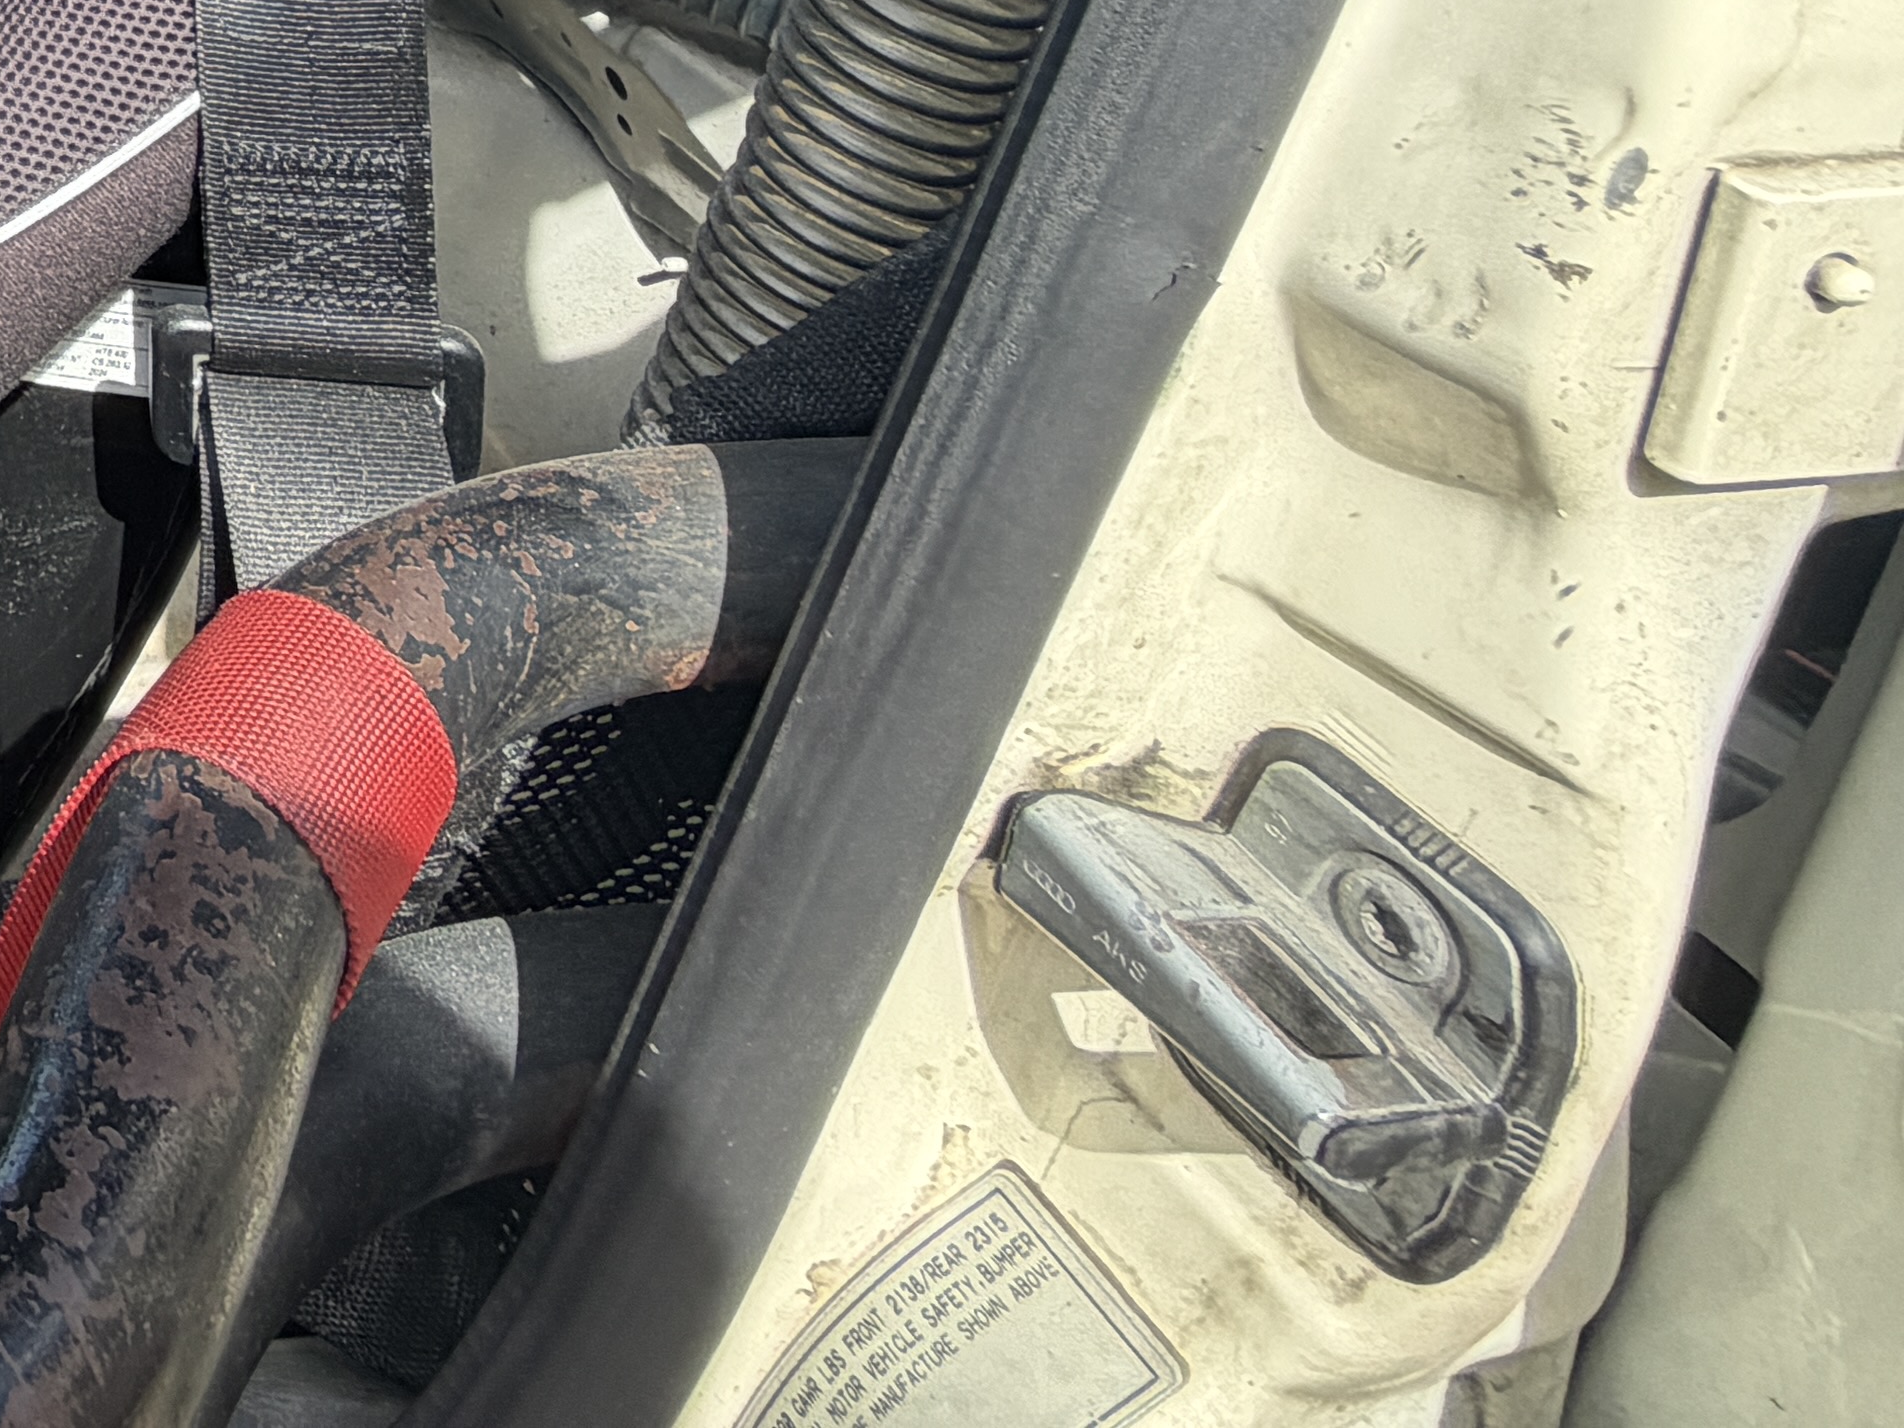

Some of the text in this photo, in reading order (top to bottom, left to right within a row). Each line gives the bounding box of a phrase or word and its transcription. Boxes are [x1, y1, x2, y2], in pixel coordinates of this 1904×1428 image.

[816, 1348, 848, 1386] LBS
[842, 1307, 888, 1357] FRONT
[825, 1374, 868, 1426] MOTOR
[862, 1319, 925, 1383] VEHICLE
[869, 1331, 960, 1423] MANUFACTURE
[957, 1294, 1011, 1342] SHOWN
[1007, 1255, 1060, 1303] ABOVE
